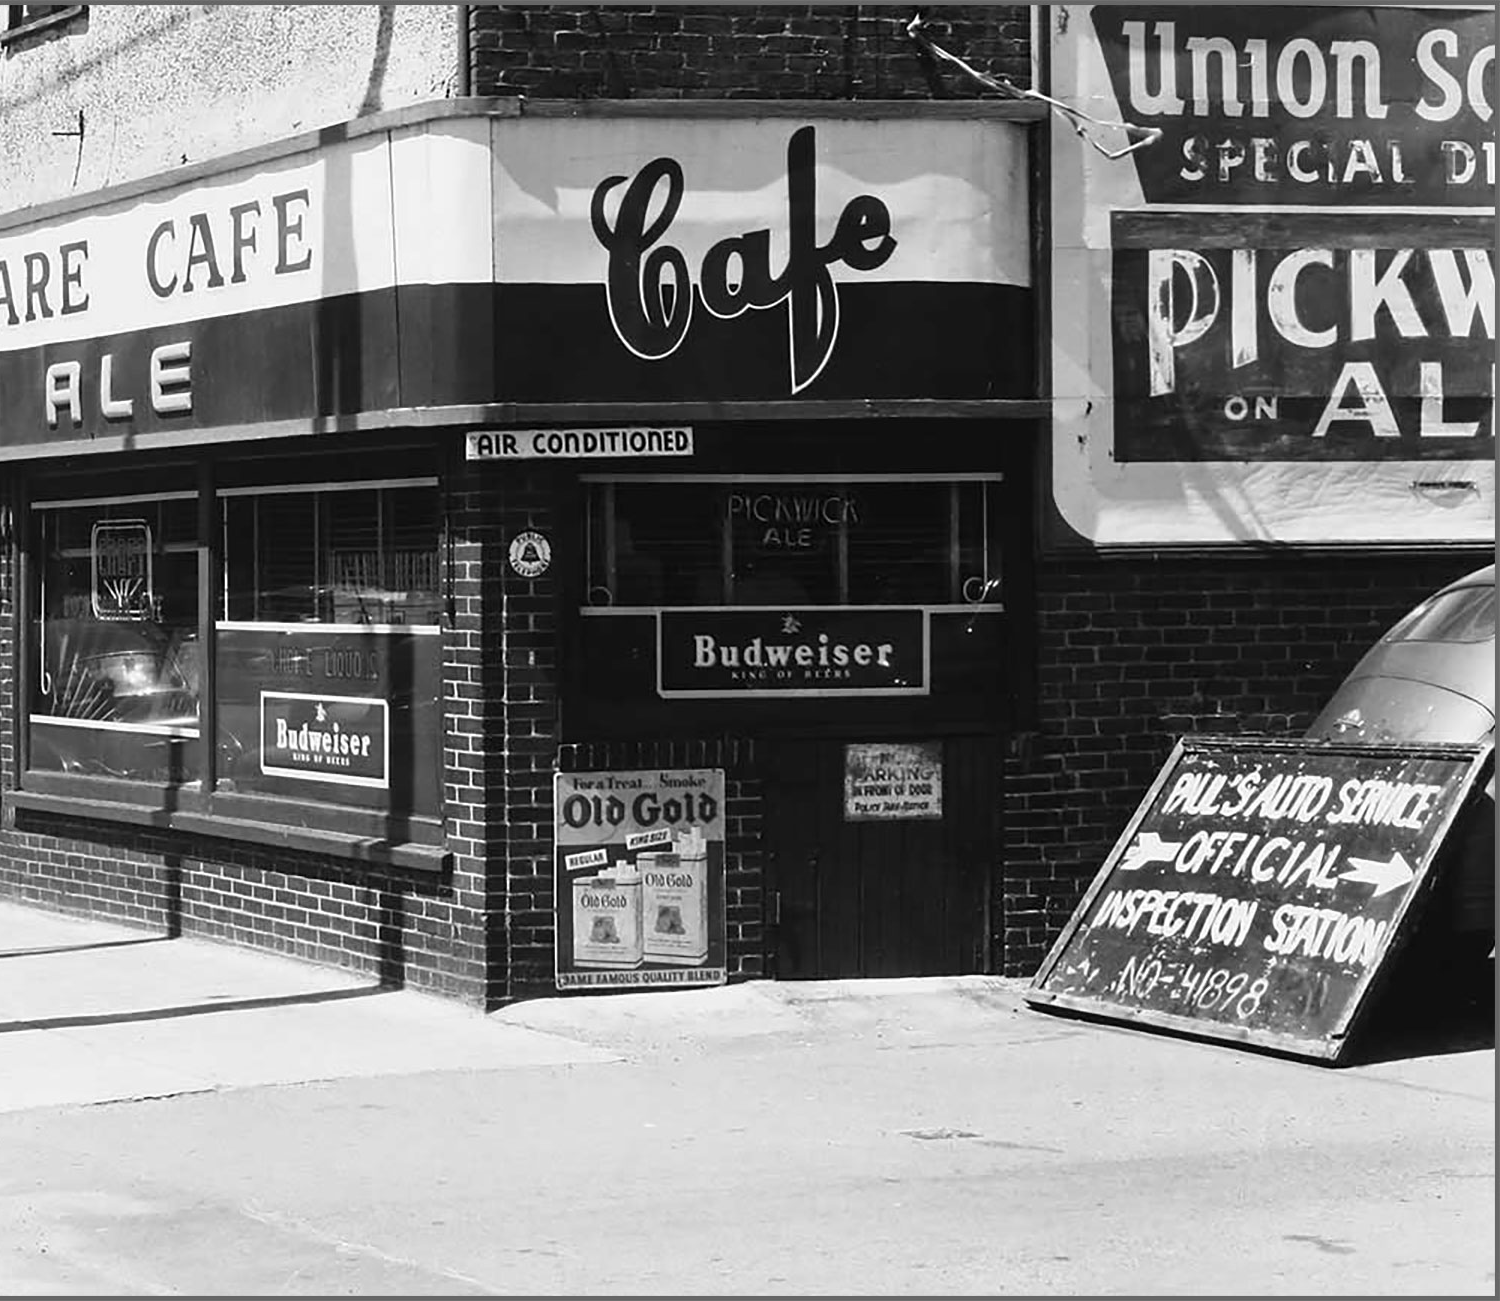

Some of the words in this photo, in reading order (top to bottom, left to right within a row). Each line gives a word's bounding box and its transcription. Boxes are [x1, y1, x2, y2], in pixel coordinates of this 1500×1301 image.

[1179, 136, 1416, 184] SPECIAL
[146, 189, 313, 299] CAFE
[590, 125, 898, 394] Cafe
[45, 340, 193, 429] ALE
[1224, 395, 1278, 421] ON
[478, 434, 518, 455] AIR
[727, 494, 859, 525] PICKWICK
[762, 528, 813, 548] ALE
[693, 632, 894, 668] Budweiser
[731, 670, 766, 681] KING
[777, 670, 793, 680] OF
[804, 669, 851, 680] BEERS
[275, 718, 371, 757] Budweiser
[659, 772, 707, 789] Smoke
[563, 793, 625, 829] Old
[632, 792, 718, 828] Gold
[1244, 775, 1334, 824] AUTO
[1327, 777, 1442, 830] SERVICE
[649, 834, 668, 843] SIZE
[1174, 831, 1344, 890] OFFICIAL
[645, 872, 665, 888] Old
[666, 871, 693, 888] Gold
[580, 894, 601, 909] Old
[602, 894, 628, 909] Gold
[1090, 889, 1259, 947] INSPECTION
[1264, 903, 1388, 968] STATION
[600, 971, 640, 985] FAMOUS
[642, 970, 685, 983] QUALITY
[687, 969, 722, 982] BLEND
